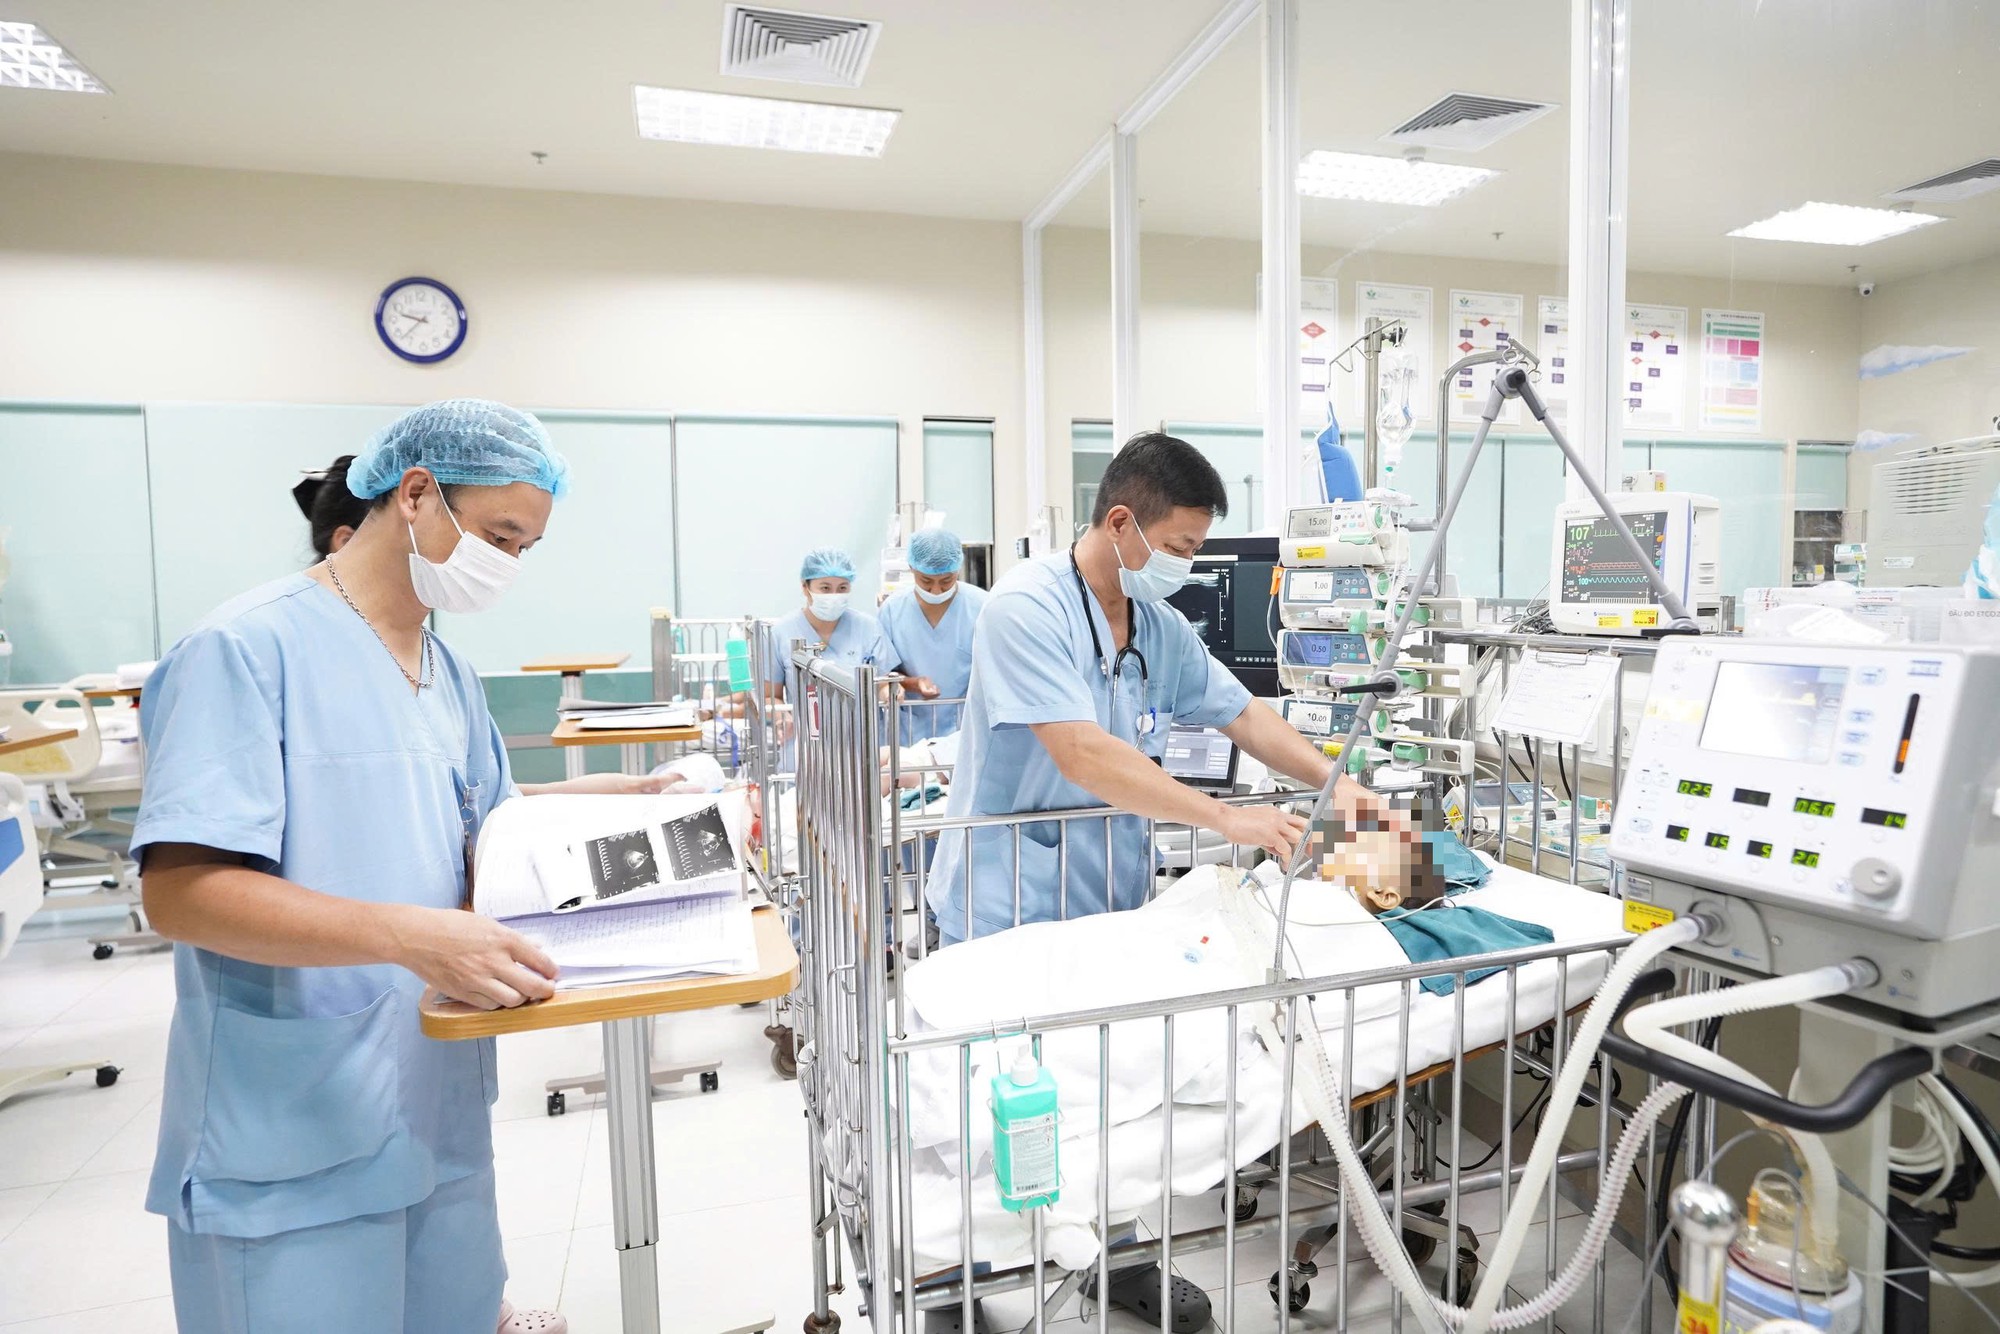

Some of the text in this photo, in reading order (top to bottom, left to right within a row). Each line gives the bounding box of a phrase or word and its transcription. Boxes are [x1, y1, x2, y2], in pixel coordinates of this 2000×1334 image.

[415, 289, 425, 302] 12
[1309, 517, 1328, 527] 15.00
[1570, 526, 1590, 541] 107
[1314, 581, 1328, 590] 1.00
[1311, 643, 1327, 653] 0.50
[1679, 781, 1712, 798] 025
[1794, 799, 1836, 818] 060
[1883, 814, 1906, 830] 14
[1711, 834, 1729, 850] 15
[1761, 844, 1772, 859] 5
[1791, 851, 1819, 868] 20
